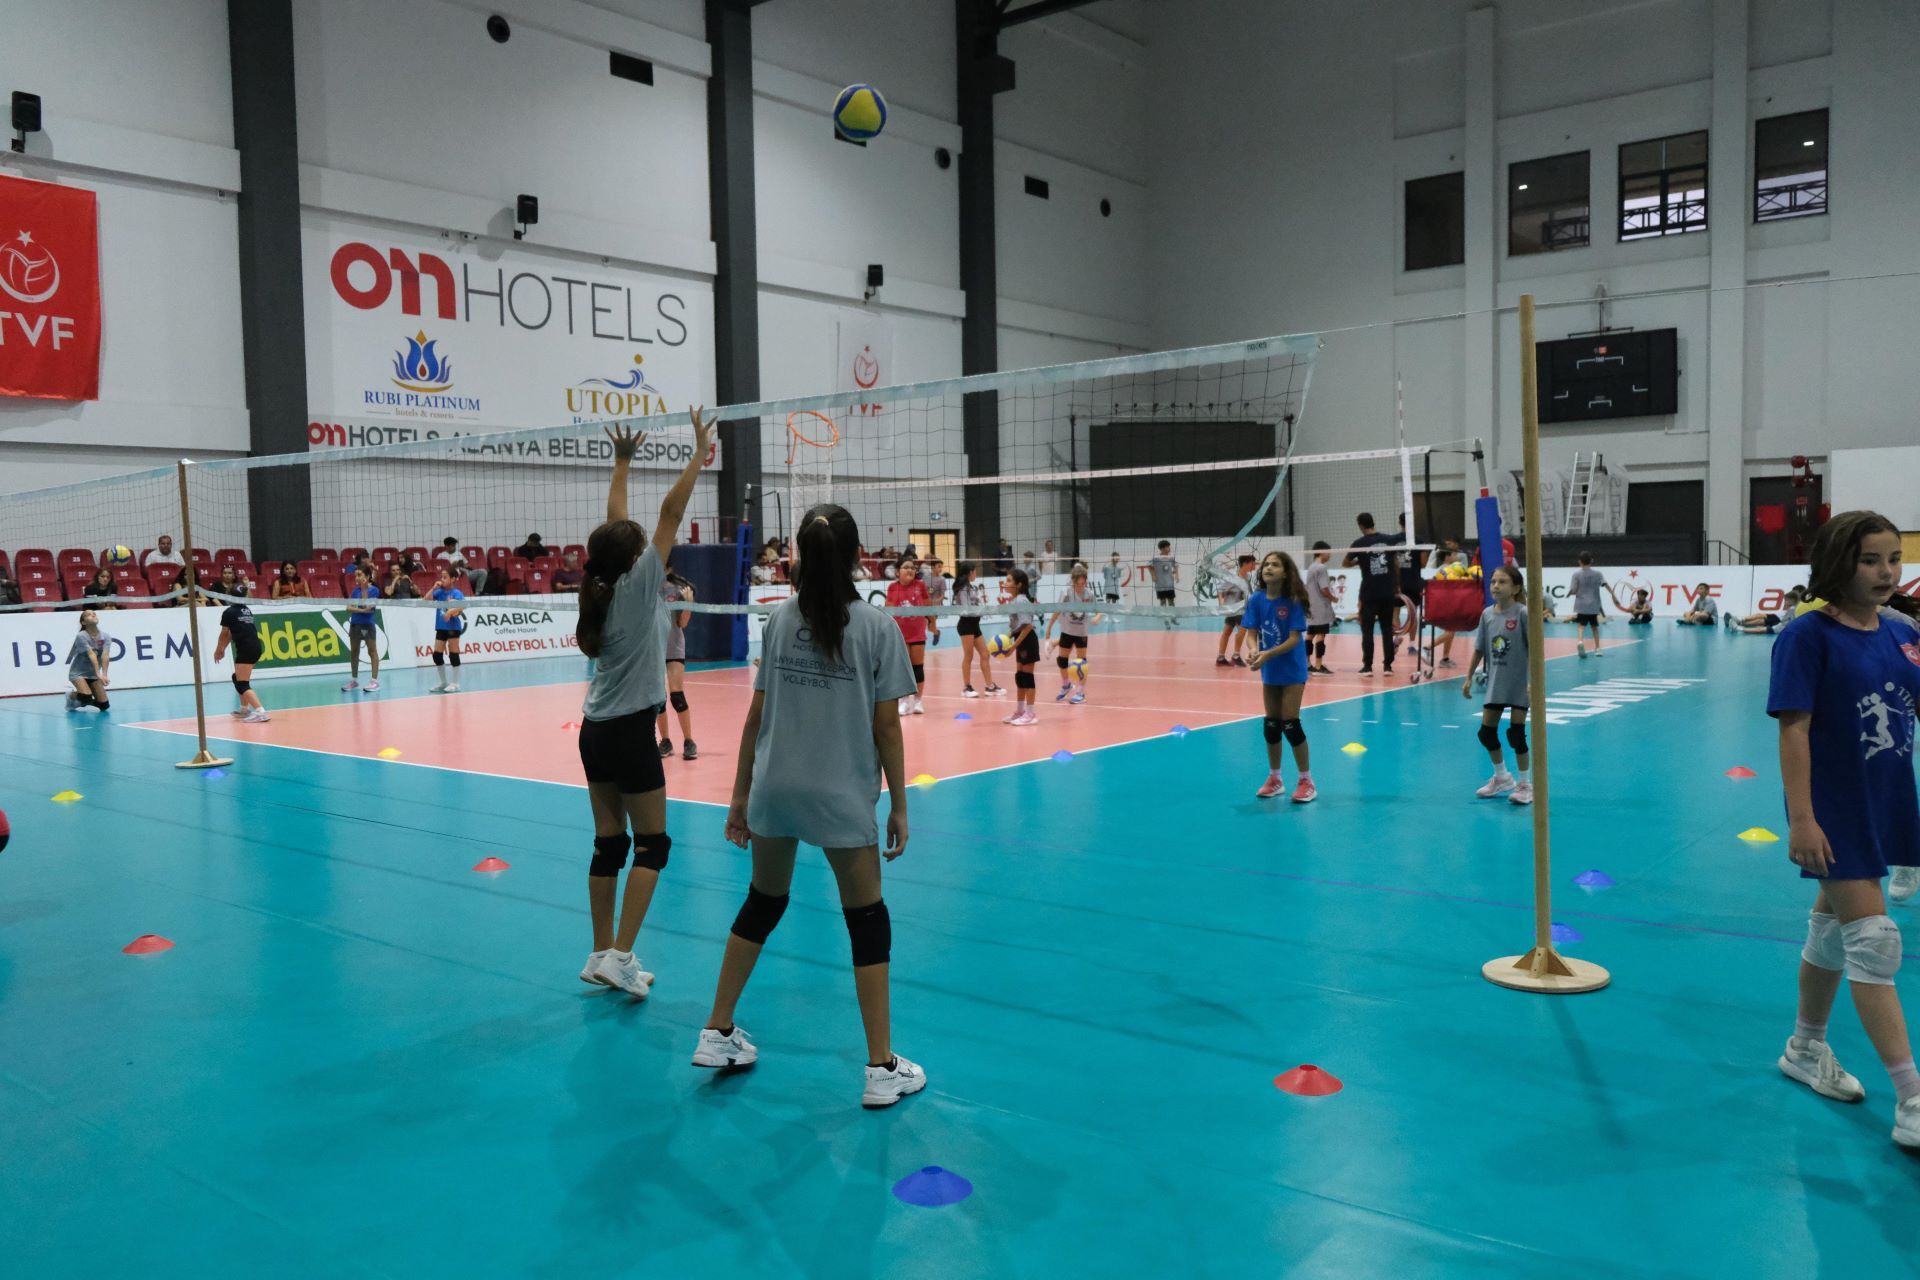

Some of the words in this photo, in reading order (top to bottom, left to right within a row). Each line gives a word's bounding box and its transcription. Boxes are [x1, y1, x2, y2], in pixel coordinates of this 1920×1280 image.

[463, 262, 688, 347] HOTELS
[0, 312, 75, 350] TVF
[364, 390, 400, 406] RUBI
[405, 393, 481, 411] PLATINUM
[564, 388, 668, 416] UTOPIA
[549, 438, 694, 462] BELEDESPOR
[475, 611, 553, 627] ARABICA
[495, 627, 516, 635] Coffee
[12, 632, 195, 668] IBDEM
[482, 638, 548, 653] VOLEYBOL
